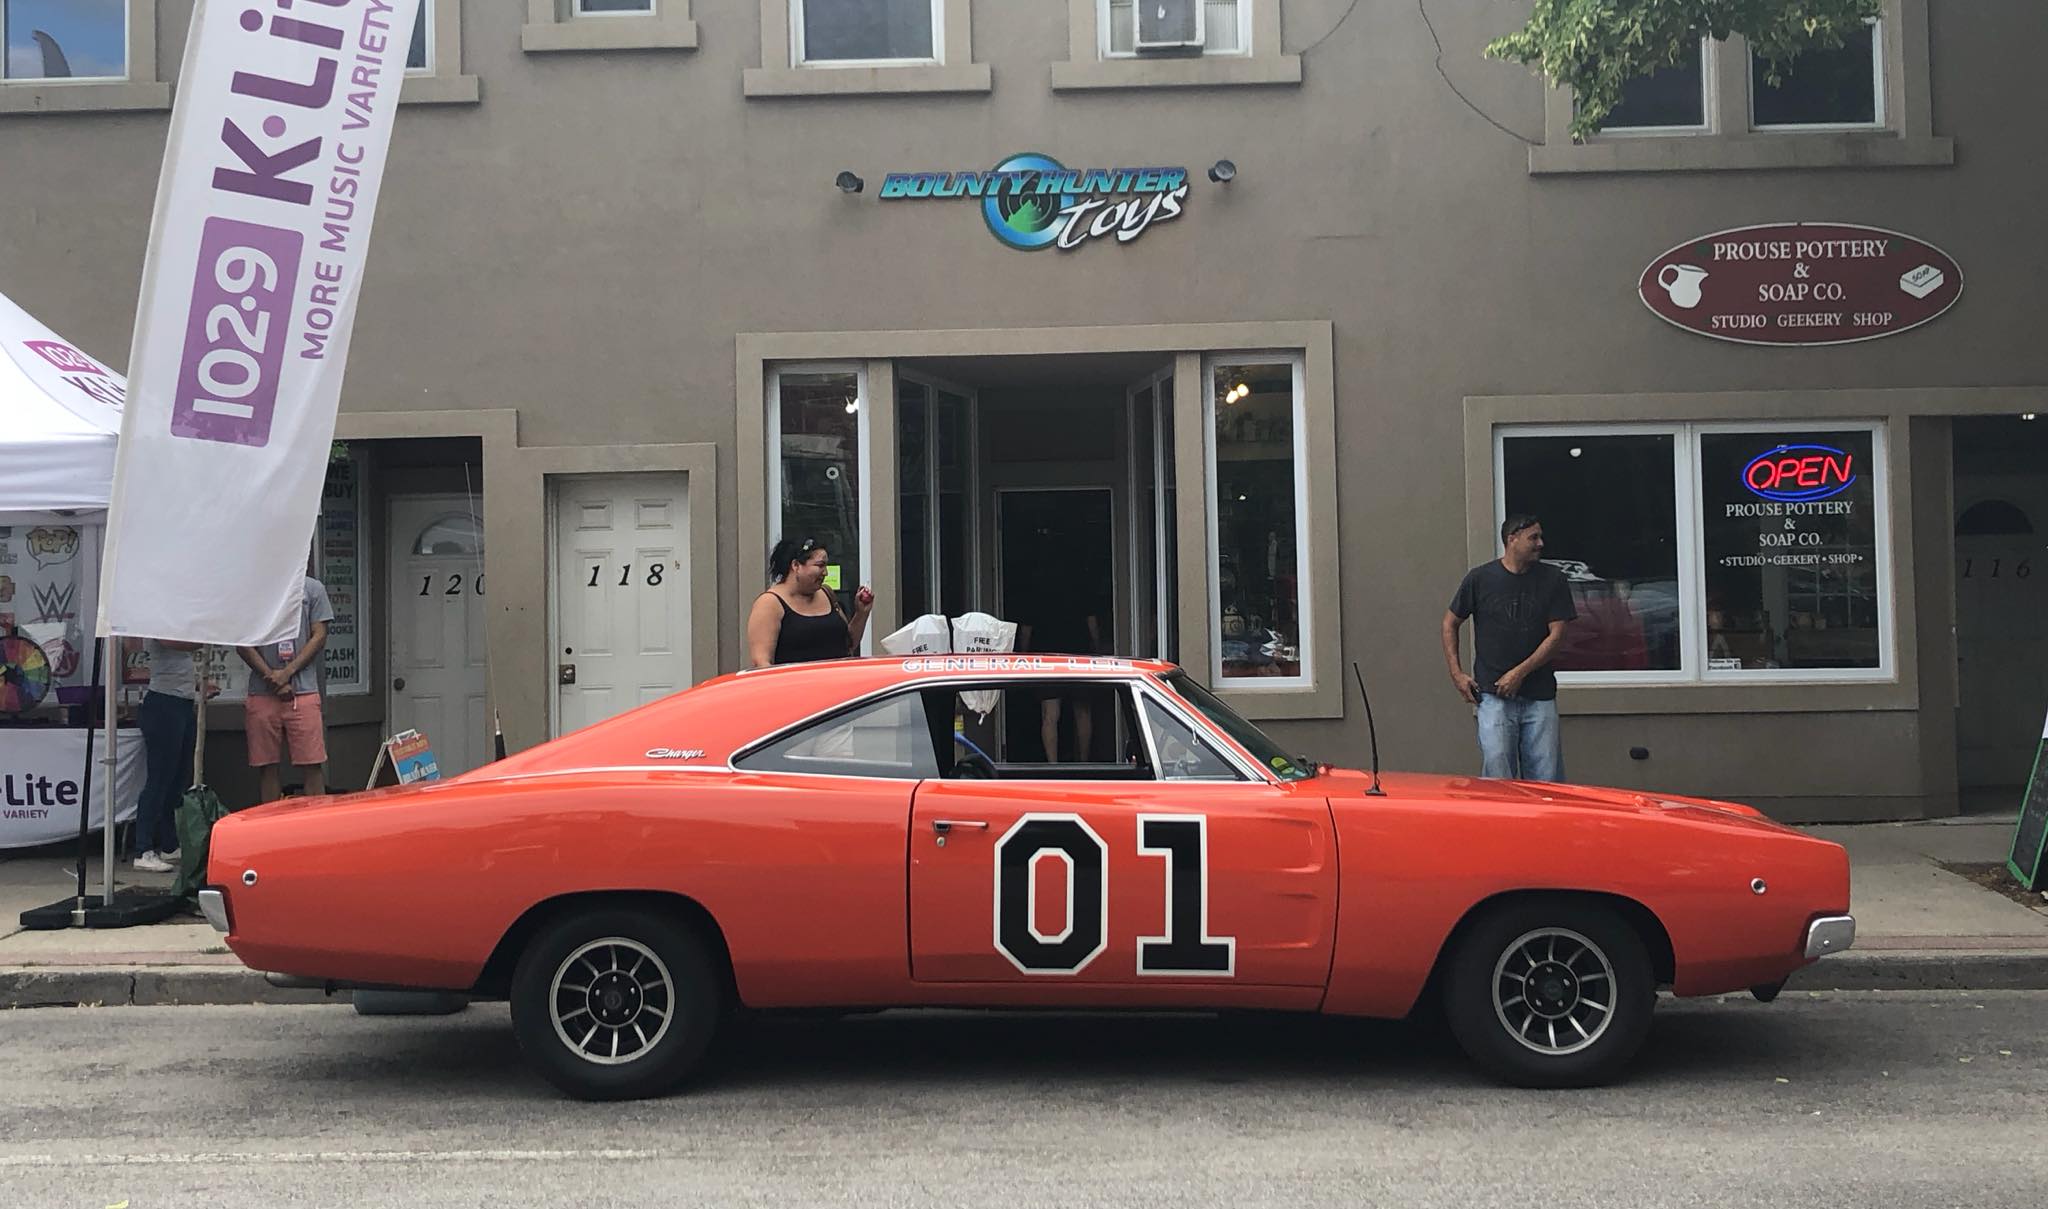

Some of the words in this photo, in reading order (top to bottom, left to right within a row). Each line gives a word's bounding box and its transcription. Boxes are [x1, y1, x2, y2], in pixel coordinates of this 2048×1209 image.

[342, 0, 394, 131] VARIETY
[879, 171, 1033, 199] BOUNTY
[1038, 167, 1187, 196] HUNTER
[320, 142, 365, 252] MUSIC
[1056, 185, 1188, 250] toys
[1713, 242, 1791, 261] PROUSE
[1795, 239, 1888, 258] POTTERY
[1793, 262, 1810, 278] &
[1911, 266, 1931, 282] SOAP
[1758, 283, 1809, 302] SOAP
[1813, 283, 1847, 301] CO.
[300, 261, 343, 360] MORE
[1712, 314, 1767, 329] STUDIO
[1777, 313, 1843, 328] GEEKERY
[1853, 312, 1893, 326] SHOP
[193, 246, 279, 419] 102.9
[1748, 454, 1852, 489] OPEN
[1726, 503, 1783, 517] PROUSE
[1785, 501, 1854, 515] POTTERY
[1784, 518, 1796, 530] &
[1759, 534, 1796, 547] SOAP
[1798, 533, 1823, 546] CO.
[1726, 556, 1766, 567] STUDIO
[1773, 555, 1821, 566] GEEKERY
[1828, 554, 1858, 564] SHOP
[973, 636, 991, 646] FREE
[324, 648, 355, 662] CASH
[325, 665, 355, 680] PAID!
[902, 657, 1055, 673] GENERAL
[1068, 658, 1134, 672] LEE
[645, 748, 705, 761] Charger
[3, 809, 49, 819] VARIETY
[994, 812, 1236, 977] 01
